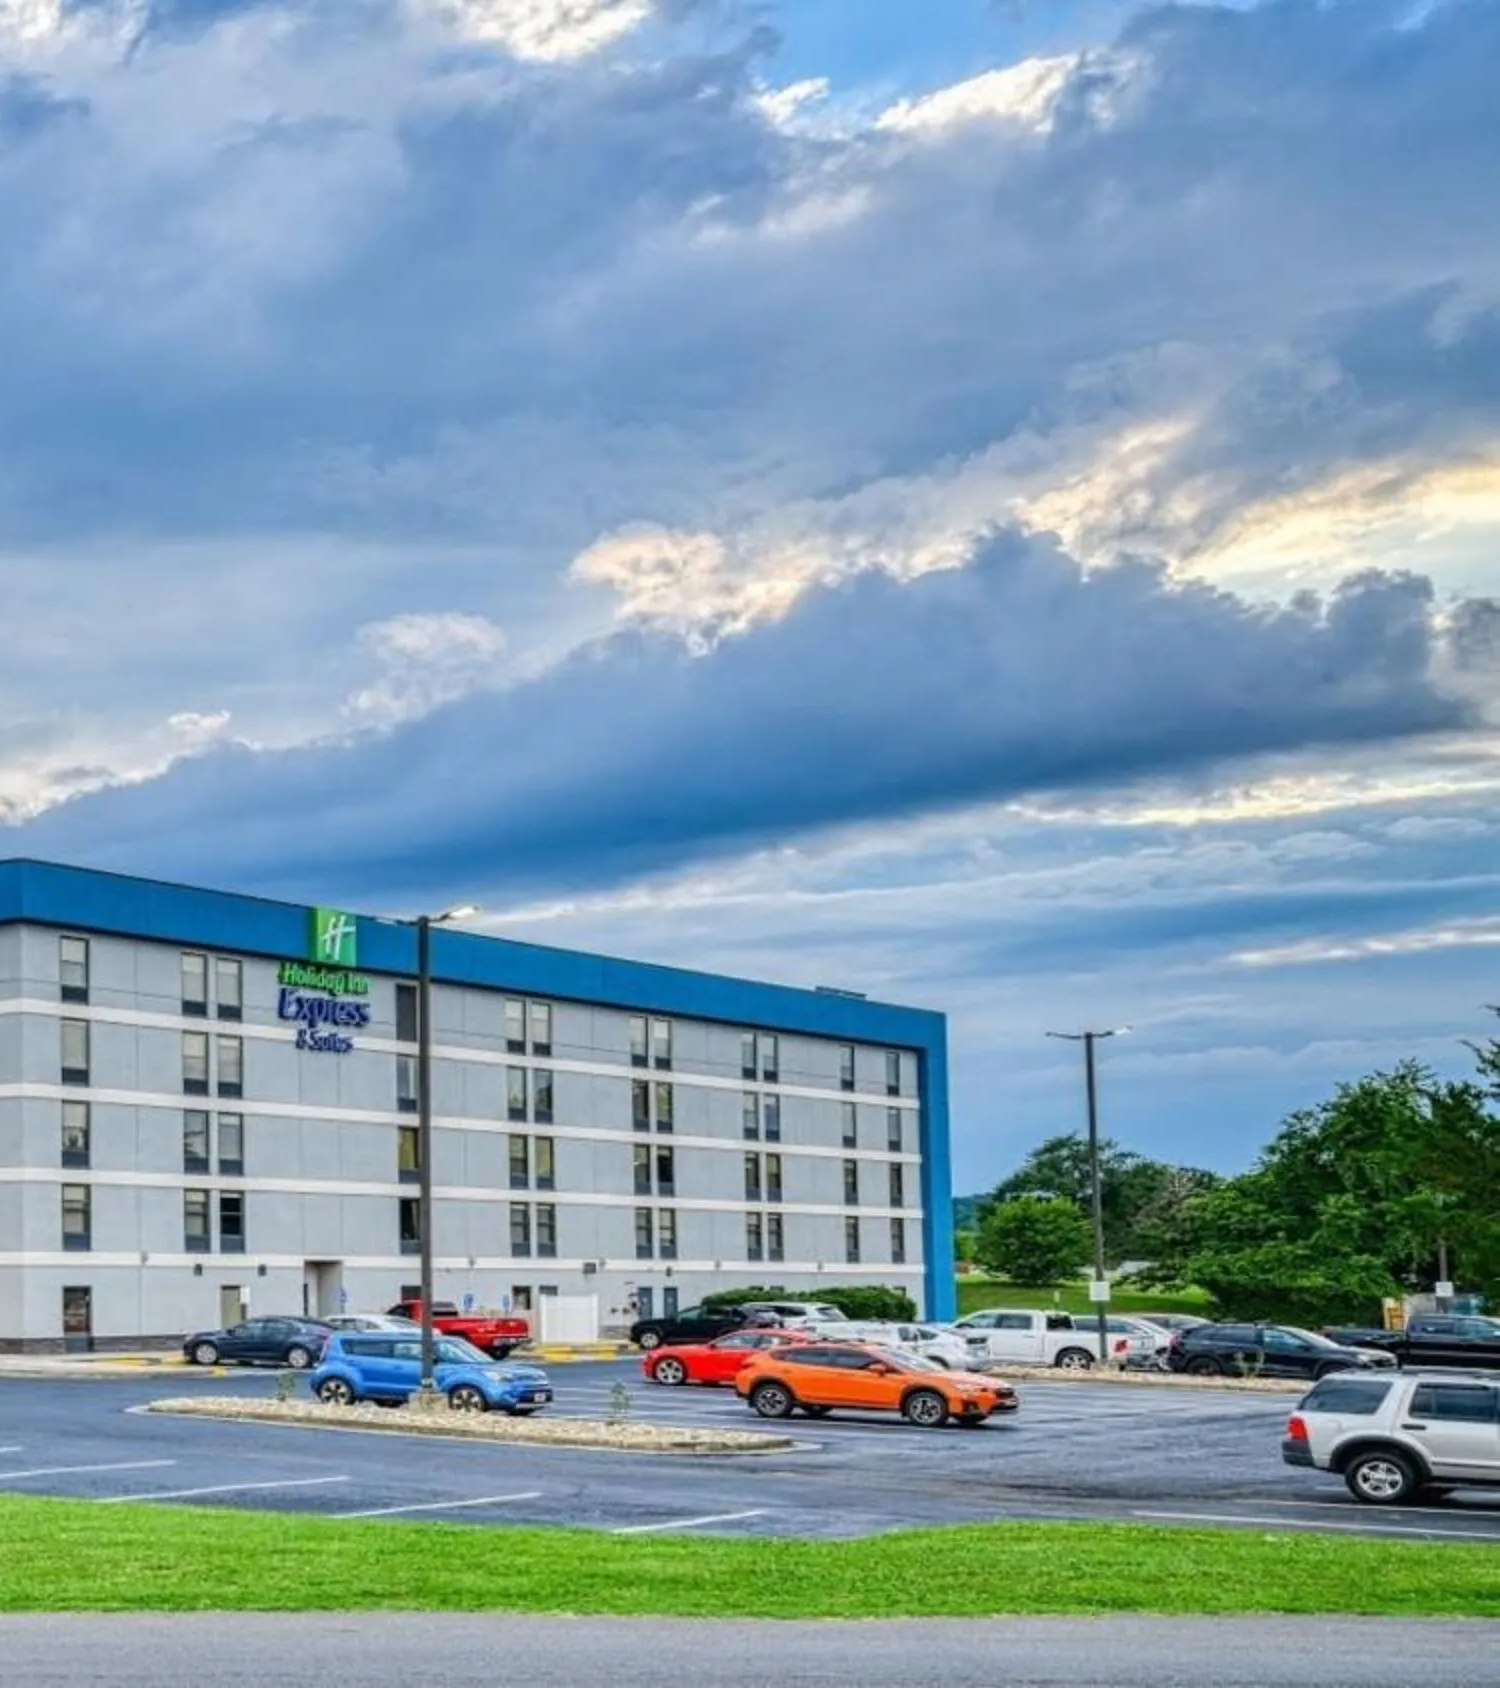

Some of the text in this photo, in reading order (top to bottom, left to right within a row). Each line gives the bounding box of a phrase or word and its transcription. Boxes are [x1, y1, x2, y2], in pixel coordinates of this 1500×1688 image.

[278, 962, 370, 995] Holiday Inn
[278, 987, 370, 1028] Express
[308, 1030, 354, 1053] Suites
